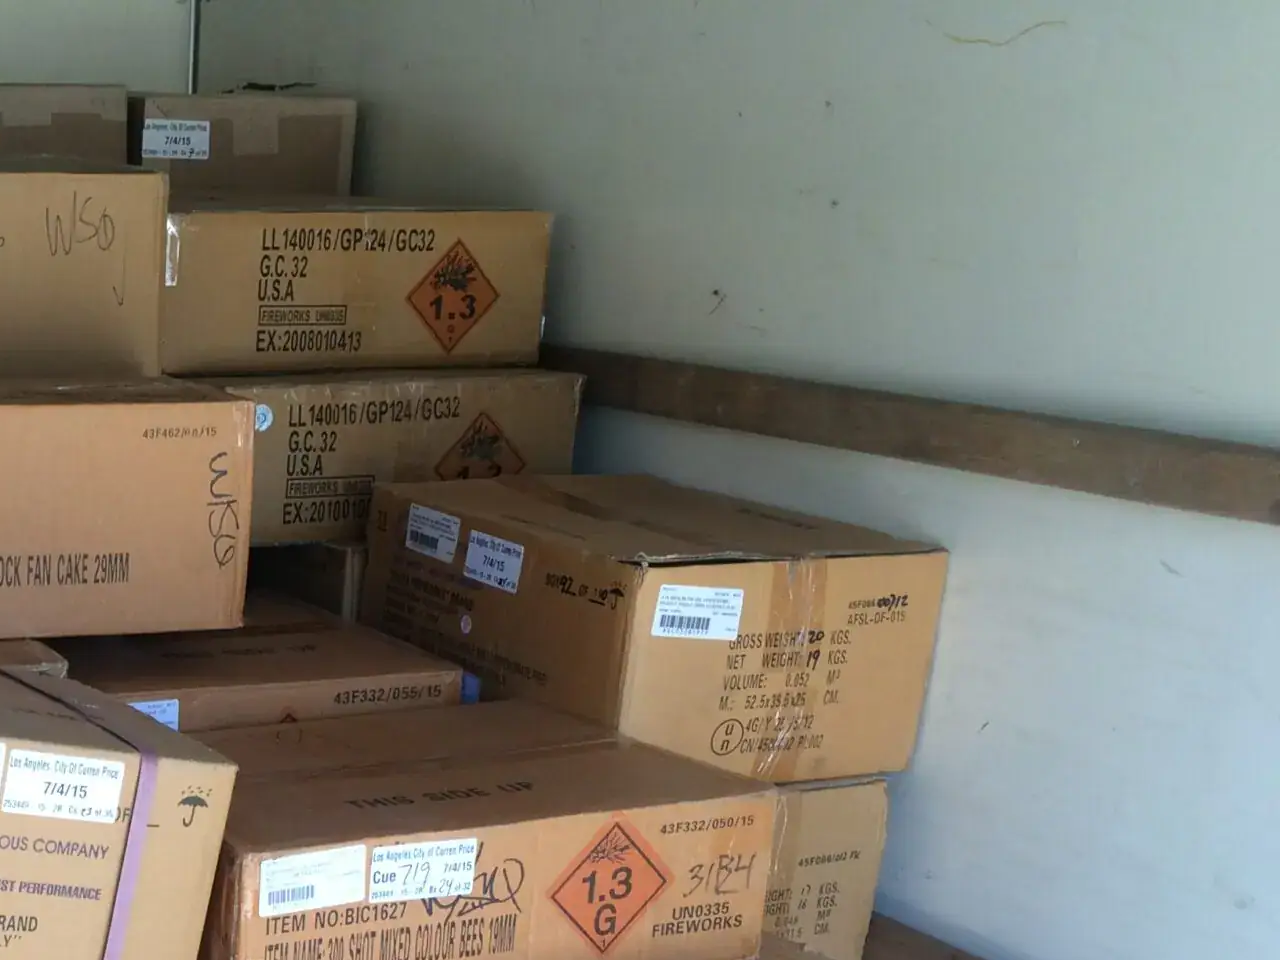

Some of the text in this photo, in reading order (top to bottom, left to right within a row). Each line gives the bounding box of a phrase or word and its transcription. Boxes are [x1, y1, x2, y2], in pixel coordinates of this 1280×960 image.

[258, 279, 294, 302] U.S.A
[261, 308, 310, 322] FIREWORKS
[287, 455, 323, 476] U.S.A
[27, 554, 51, 586] FAN
[57, 553, 88, 585] CAKE
[94, 552, 130, 584] 29MM
[43, 780, 88, 798] 7/4/15
[660, 815, 754, 835] 43F332/050/15
[32, 837, 110, 860] COMPANY
[373, 861, 472, 884] Cue 7/4/15
[399, 861, 431, 885] 719
[18, 880, 102, 901] PERFORMANCE
[582, 866, 633, 904] 1.3
[594, 904, 617, 936] G
[672, 901, 729, 921] UN0335
[266, 916, 306, 935] ITEM
[459, 917, 484, 959] BEES
[488, 913, 517, 952] 19MM
[652, 915, 742, 938] FIREWORKS
